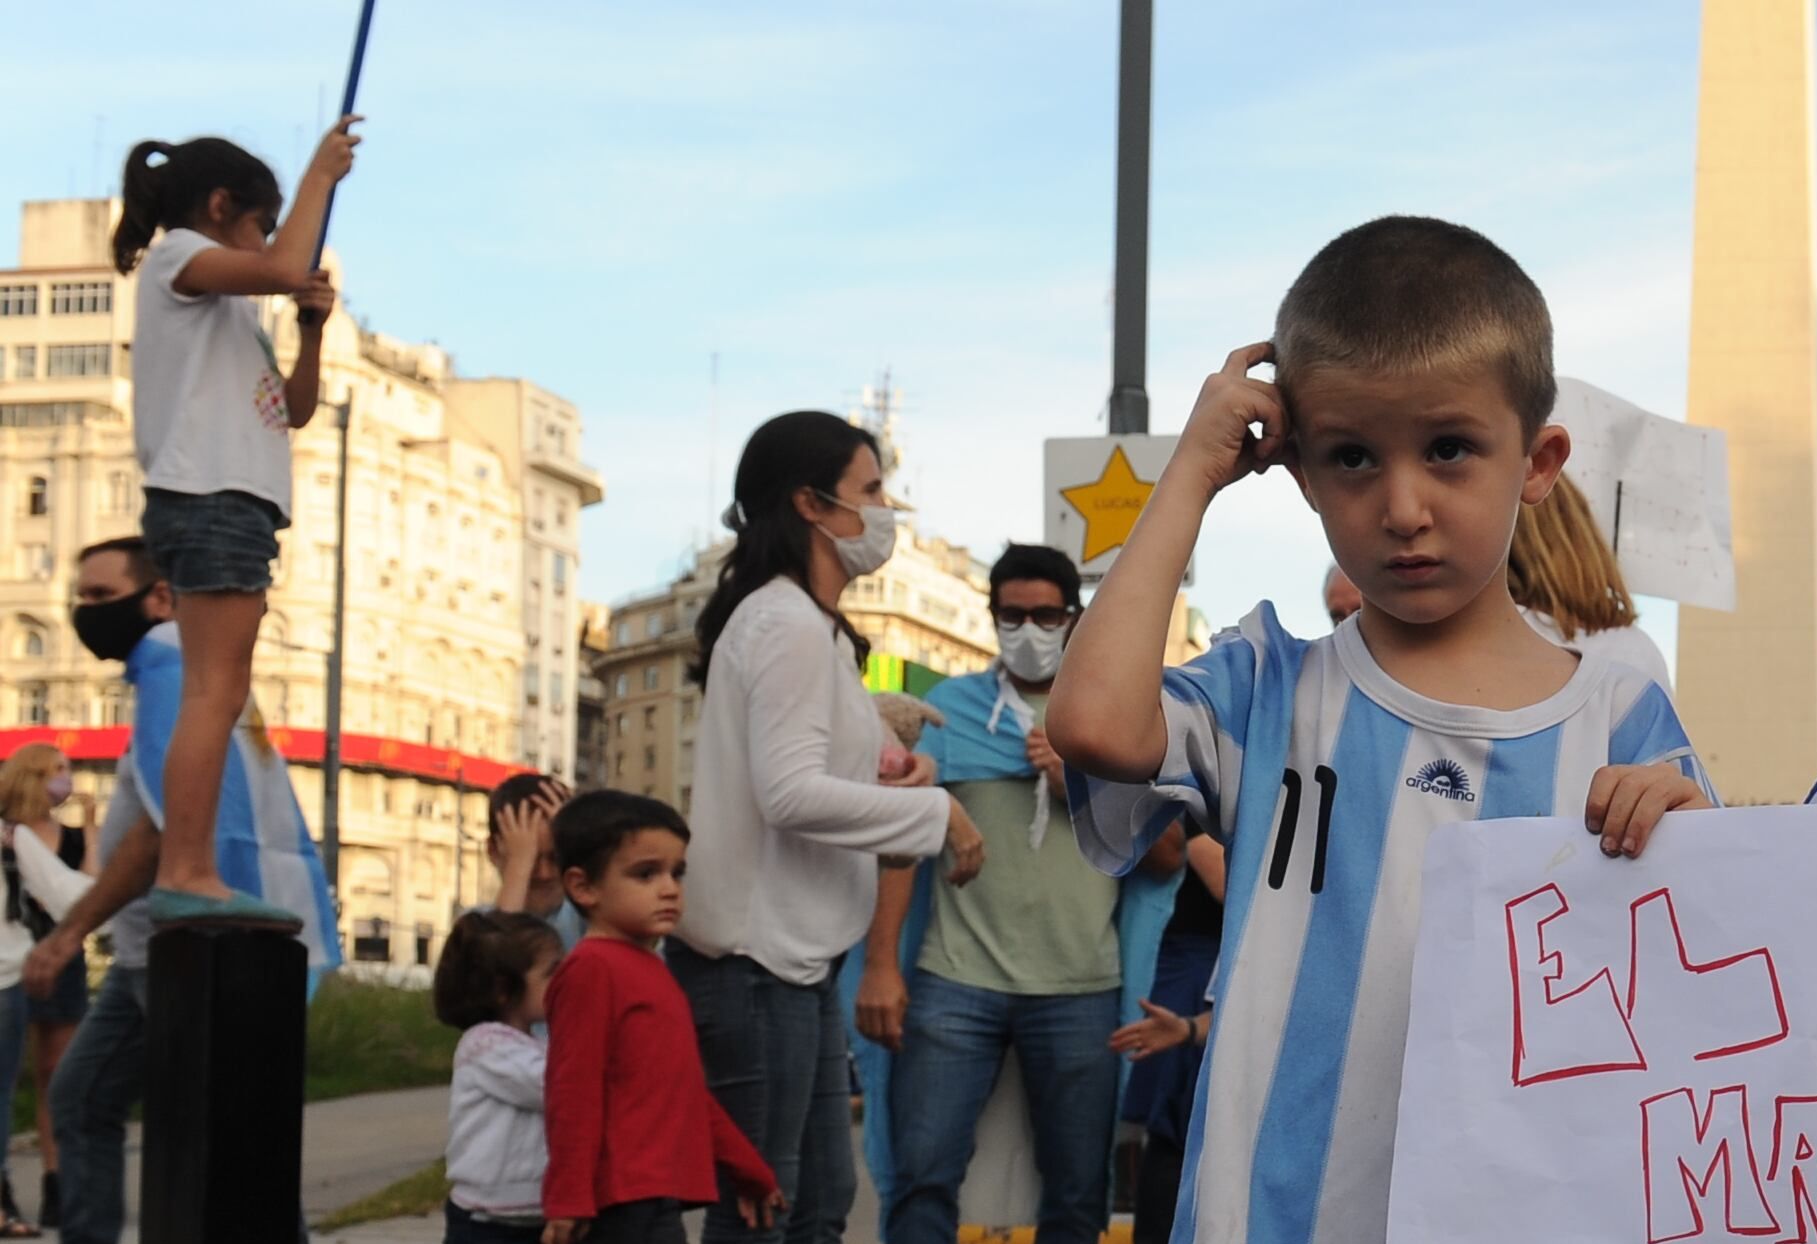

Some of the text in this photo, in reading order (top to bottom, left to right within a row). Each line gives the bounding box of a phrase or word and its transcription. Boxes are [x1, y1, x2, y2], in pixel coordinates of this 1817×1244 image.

[1268, 765, 1337, 894] 11
[1406, 777, 1475, 802] argentina
[1504, 882, 1789, 1087] EL
